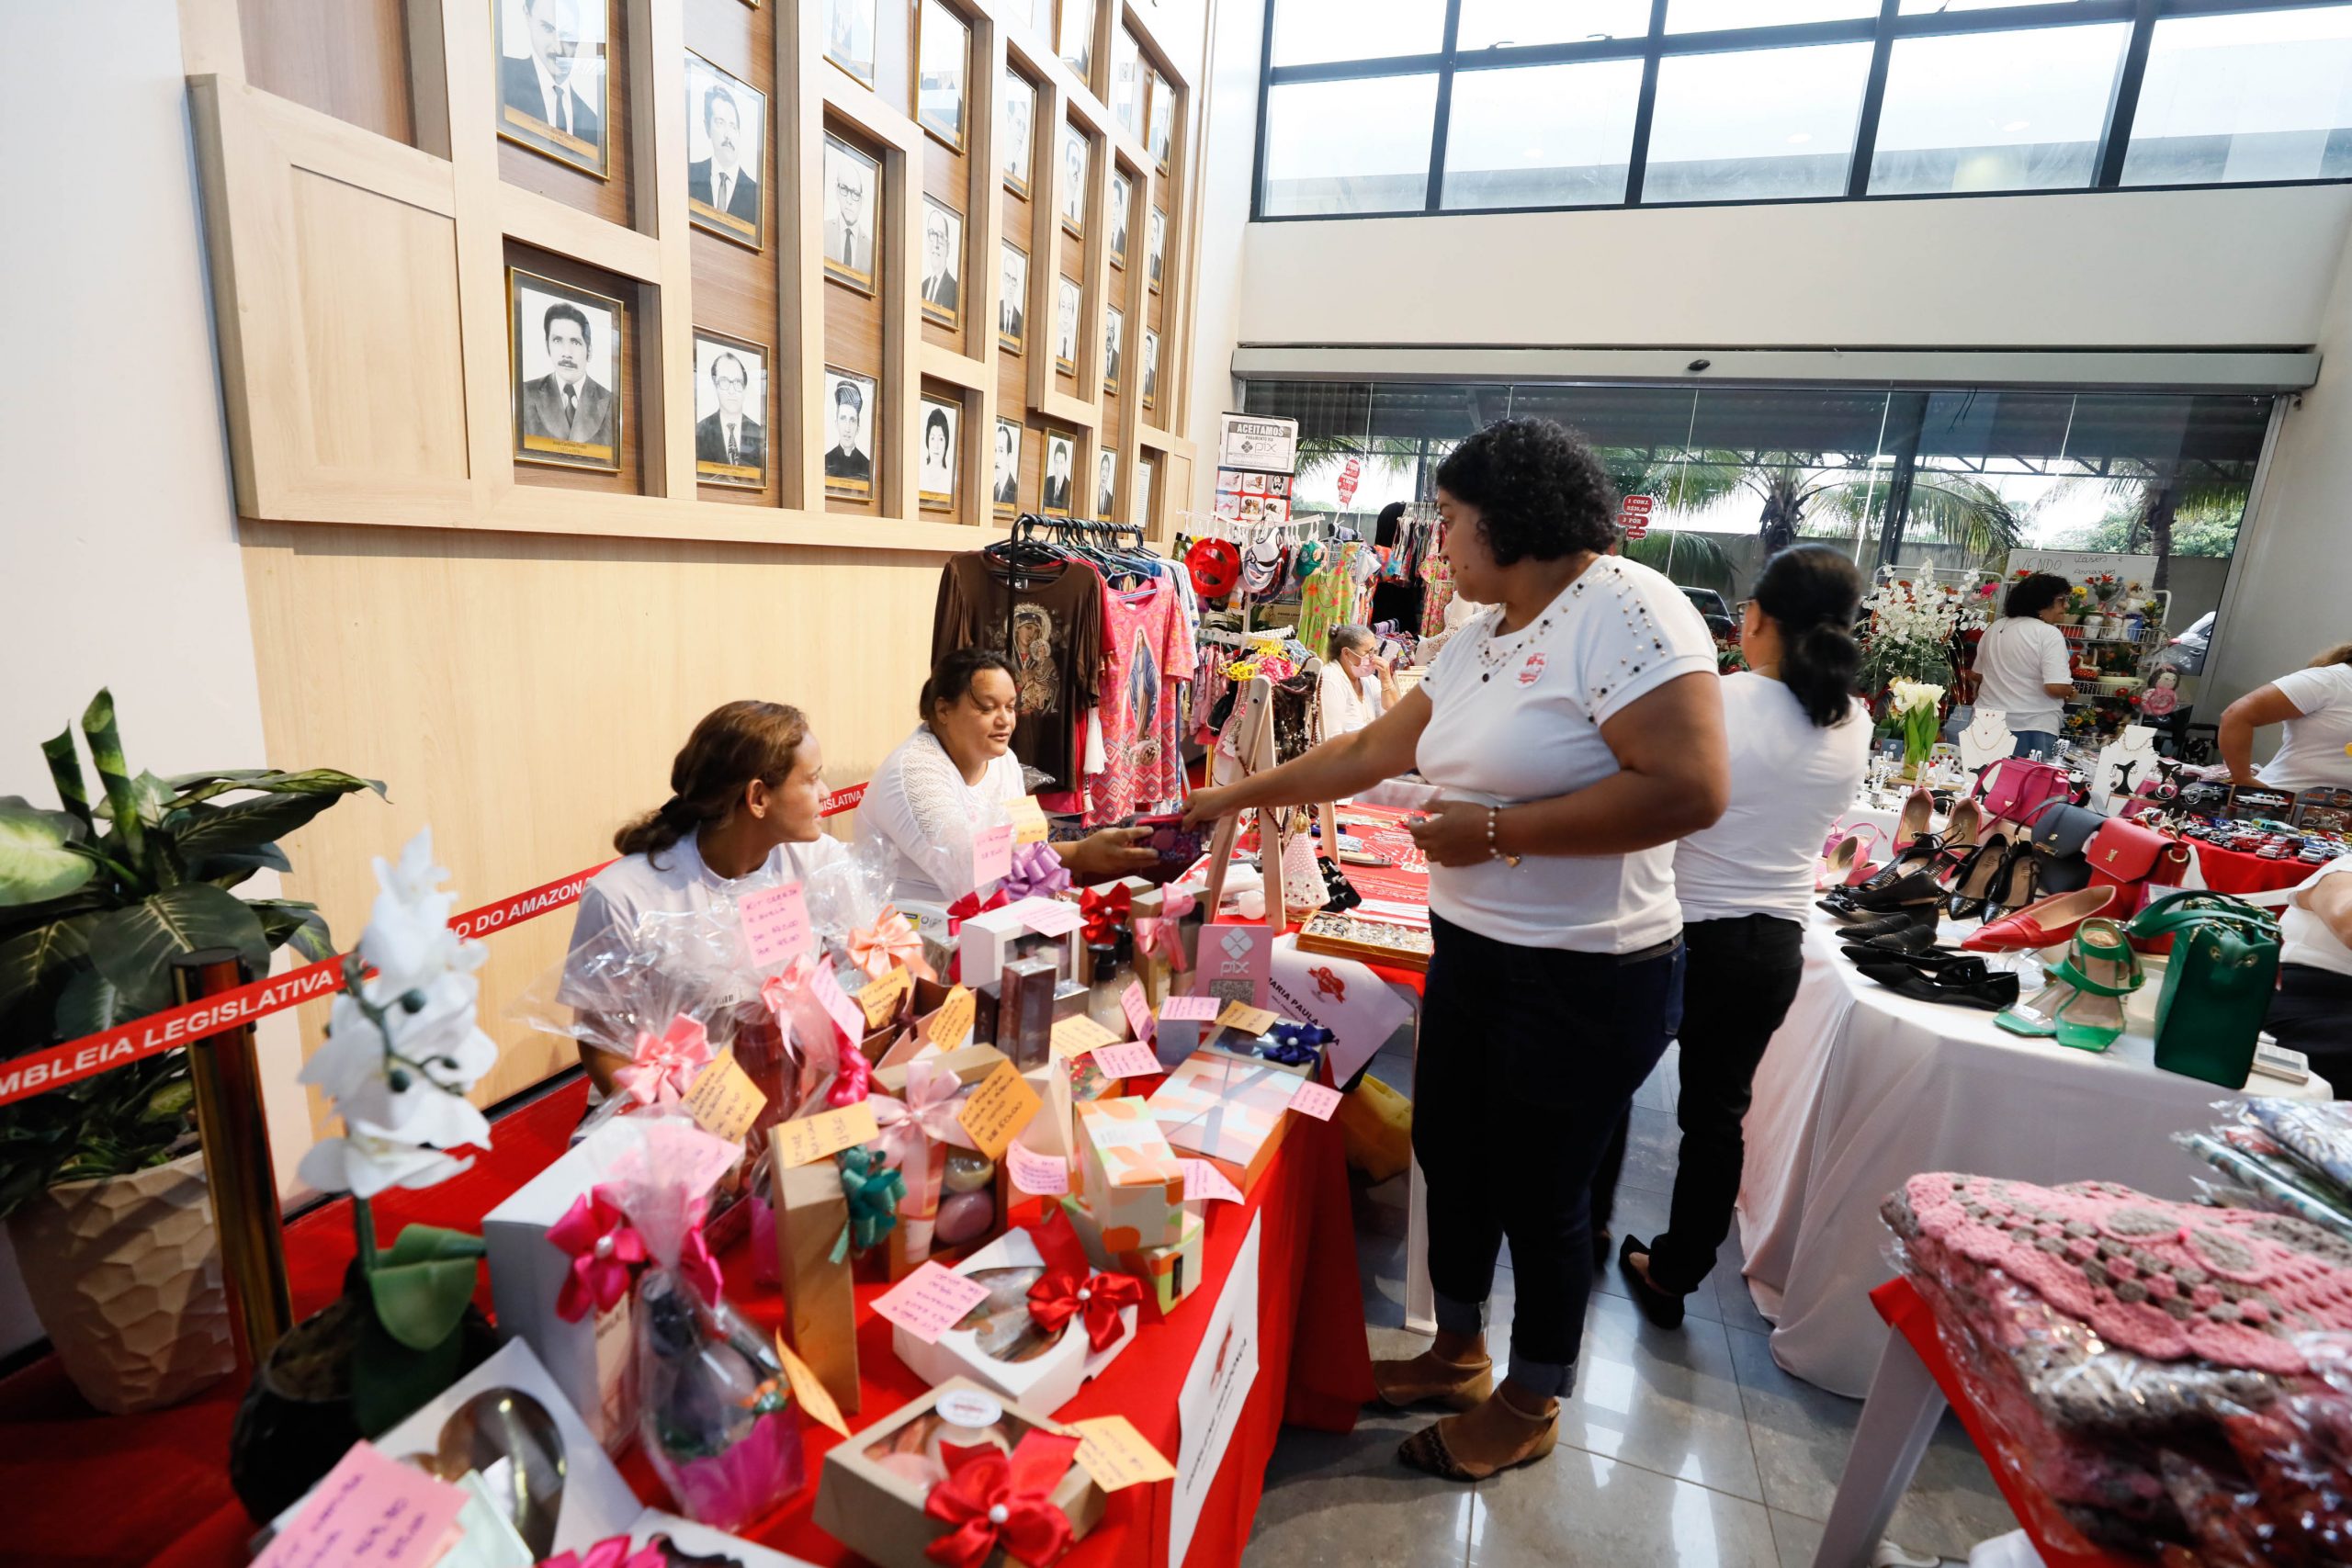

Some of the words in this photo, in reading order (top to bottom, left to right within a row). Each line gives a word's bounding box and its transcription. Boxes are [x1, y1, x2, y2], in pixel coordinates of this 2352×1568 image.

[1237, 423, 1284, 436] ACEITAMOS
[1254, 441, 1278, 455] pix
[2016, 557, 2063, 571] VENDO
[822, 791, 862, 811] ISLATIVA
[475, 909, 504, 932] DO
[507, 879, 586, 920] AMAZON
[1220, 960, 1250, 977] pix
[143, 969, 334, 1048] LEGISLATIVA
[1268, 976, 1290, 1000] ARIA
[1291, 998, 1319, 1026] PAULA
